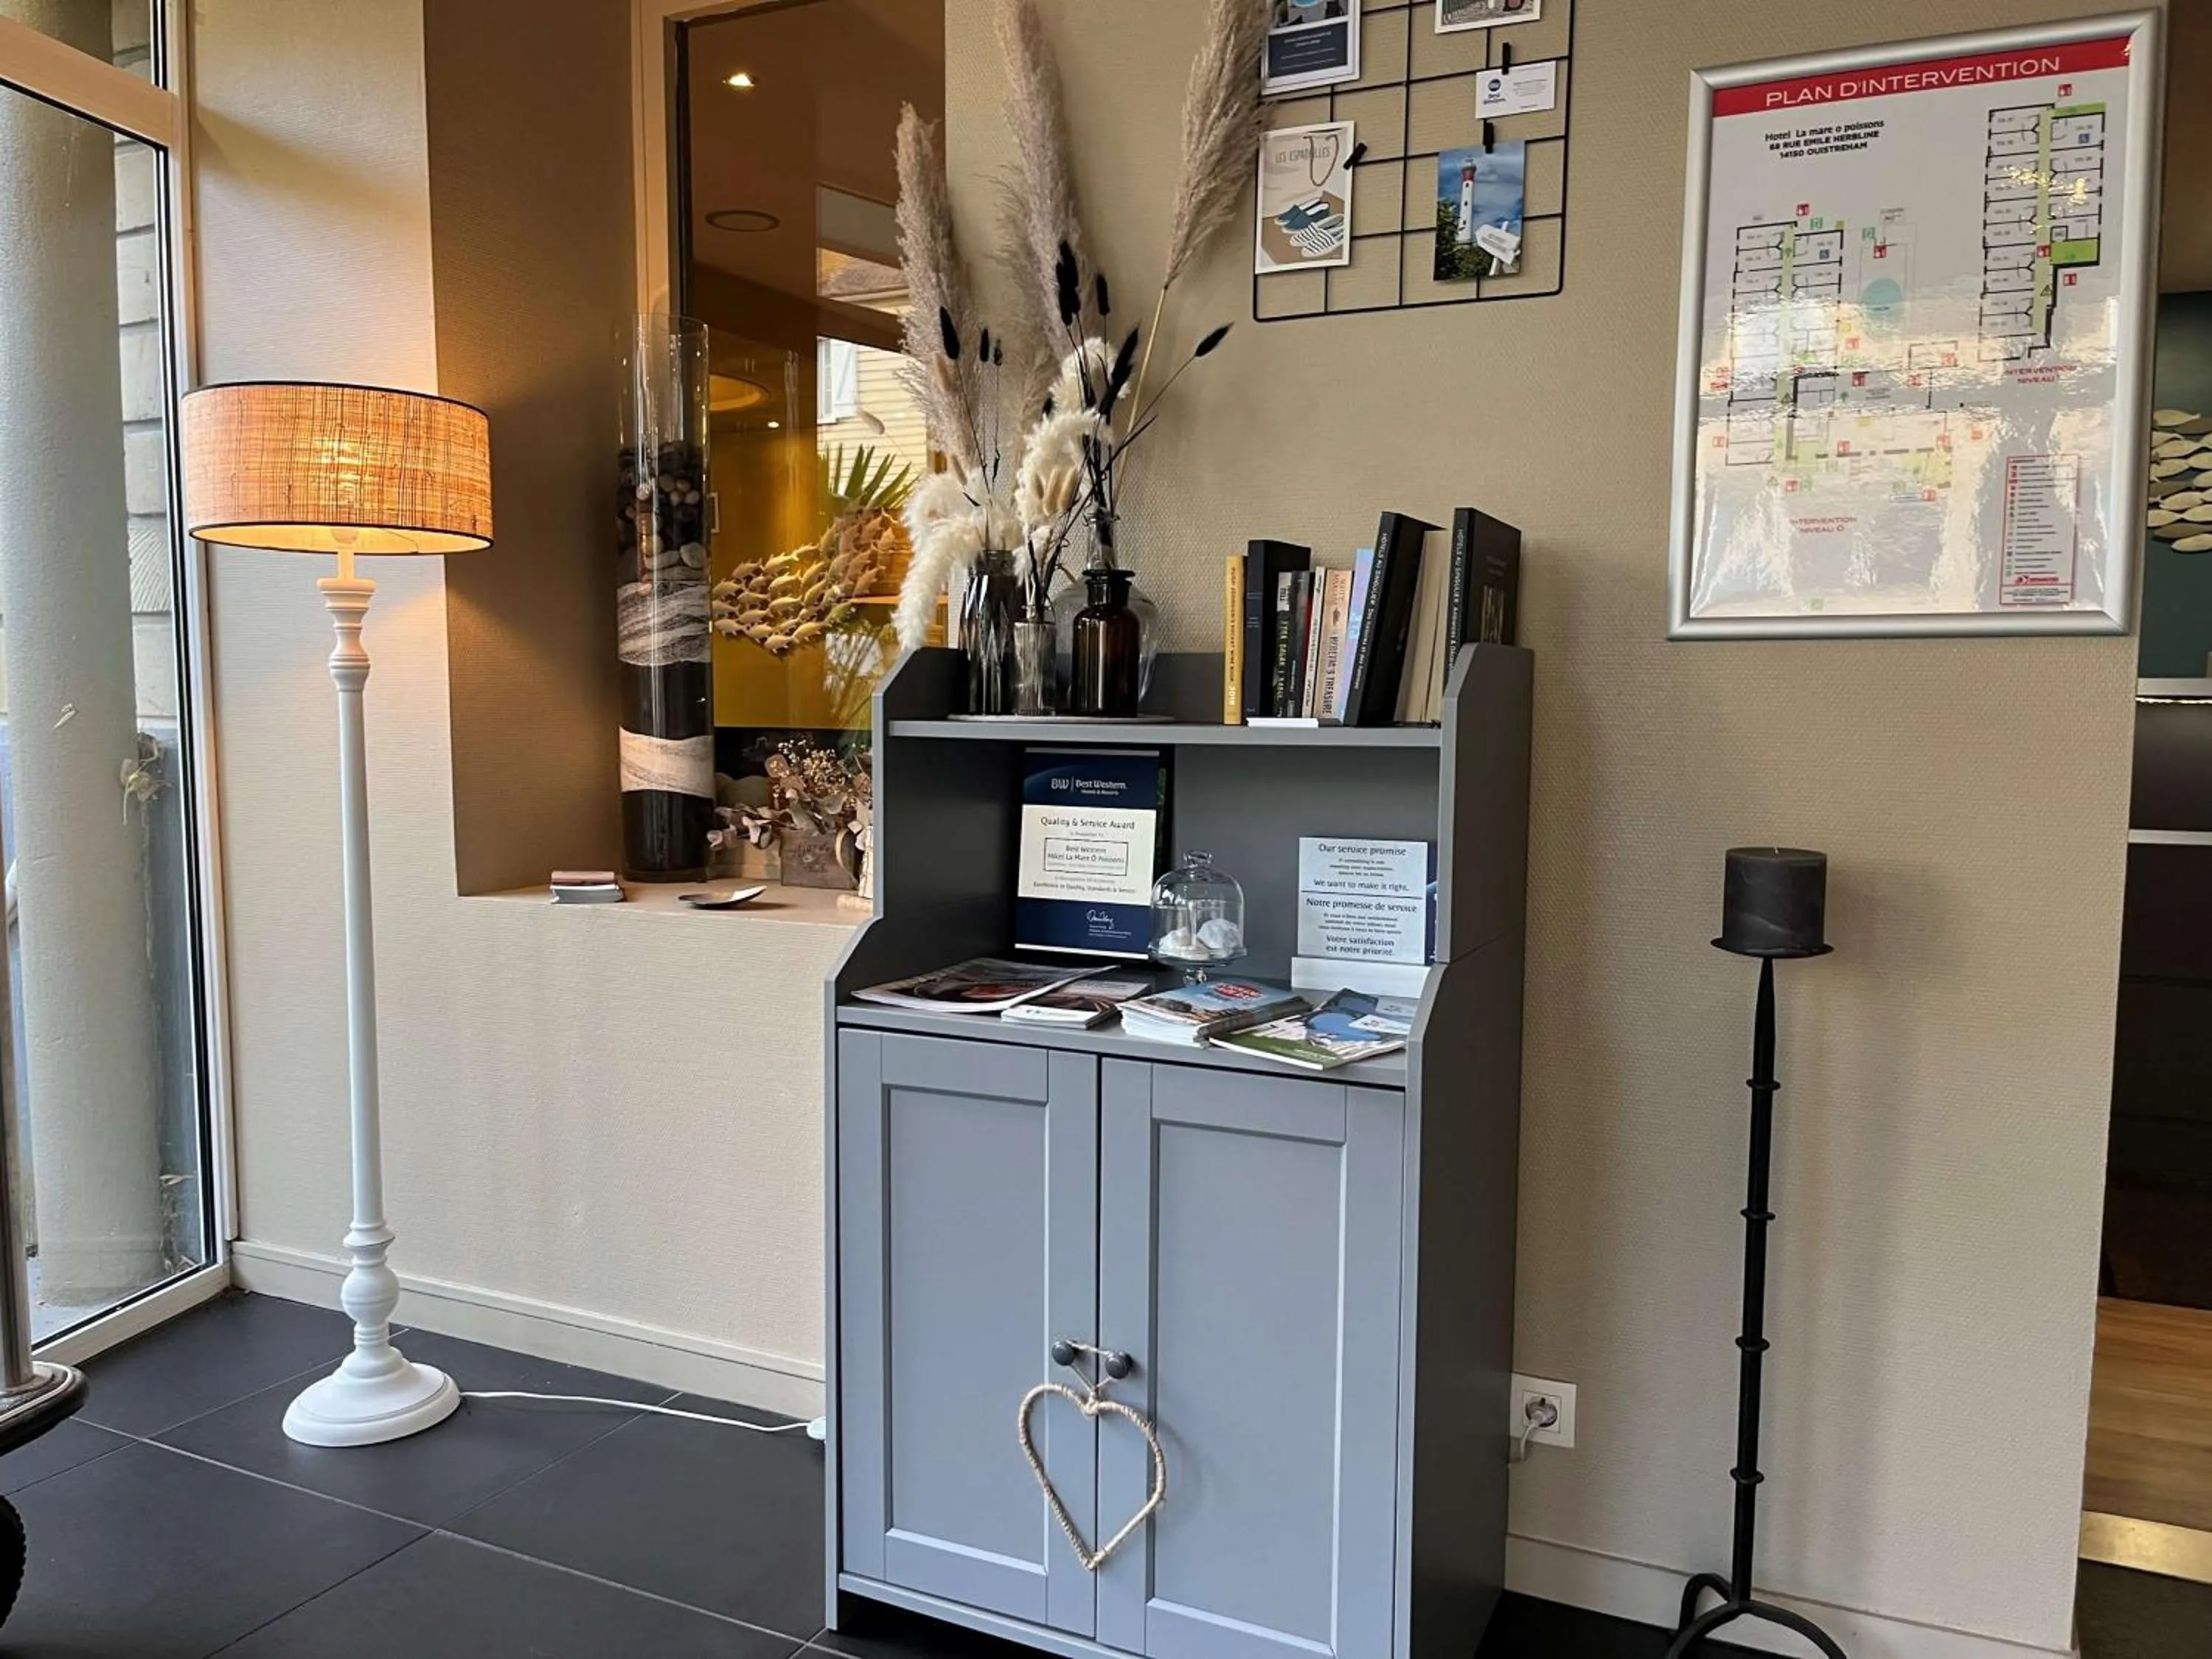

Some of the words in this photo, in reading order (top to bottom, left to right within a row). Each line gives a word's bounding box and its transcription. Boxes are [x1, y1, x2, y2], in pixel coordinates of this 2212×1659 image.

[1766, 85, 1832, 106] PLAN
[1840, 57, 2059, 97] D'INTERVENTION
[1795, 129, 1806, 138] La
[1809, 126, 1833, 136] mare
[1844, 120, 1885, 133] poissons
[1783, 139, 1801, 148] RUE
[1804, 136, 1832, 147] EMILE
[1833, 131, 1880, 143] HERBLINE
[1276, 151, 1287, 164] LES
[1779, 149, 1804, 159] 14150
[1806, 142, 1868, 155] OUISTREHAM
[1322, 675, 1335, 714] TREASURE
[1051, 778, 1069, 790] BW
[1075, 779, 1093, 788] Best
[1040, 816, 1070, 827] Quality
[1072, 818, 1078, 827] &
[1080, 818, 1107, 827] Service
[1109, 821, 1135, 830] Award
[1318, 843, 1336, 852] Our
[1338, 845, 1367, 854] service
[1369, 846, 1407, 856] promise
[1381, 883, 1388, 891] it
[1306, 897, 1331, 907] Notre
[1332, 901, 1373, 911] promesse
[1374, 902, 1385, 911] de
[1387, 904, 1418, 913] service
[1326, 934, 1347, 943] Votre
[1349, 936, 1395, 947] satisfaction
